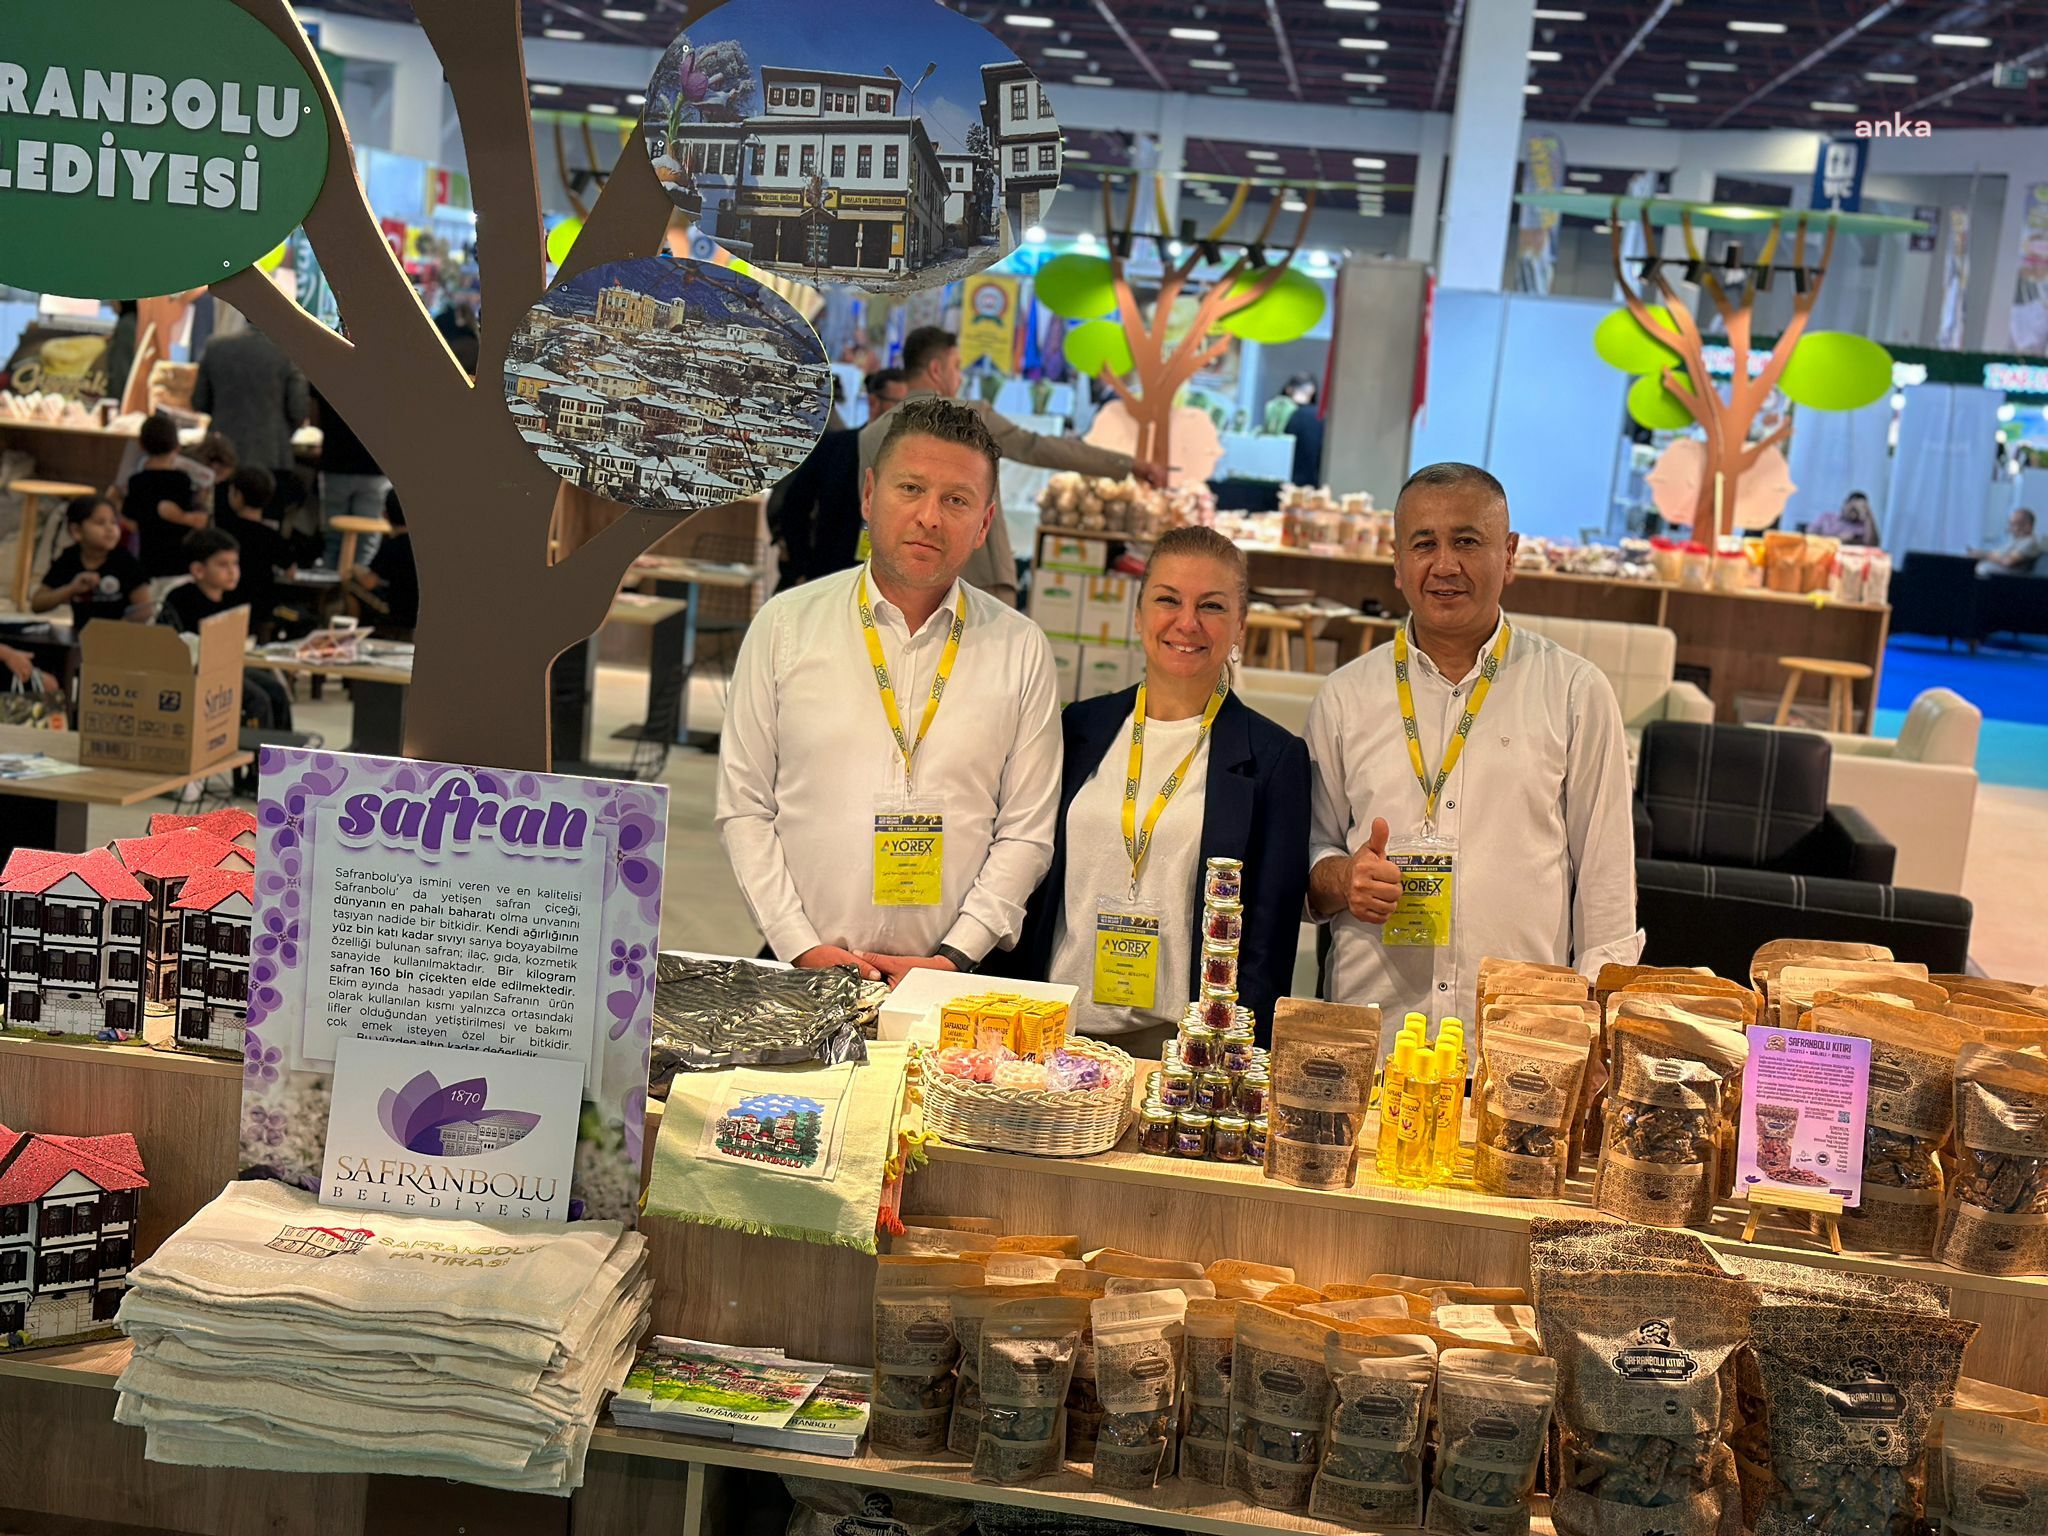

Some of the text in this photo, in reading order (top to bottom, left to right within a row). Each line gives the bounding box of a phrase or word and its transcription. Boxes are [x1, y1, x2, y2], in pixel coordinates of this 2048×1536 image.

[338, 777, 588, 850] safran
[412, 888, 427, 899] da
[441, 892, 481, 907] yetişen
[495, 897, 530, 909] safran
[544, 902, 580, 916] çiçeği,
[419, 875, 451, 888] ismini
[458, 881, 489, 892] veren
[496, 885, 510, 894] ve
[515, 887, 530, 896] en
[537, 887, 581, 901] kalitelisi
[333, 895, 579, 928] dünyanın en pahalı baharatı olma unvanını
[333, 908, 578, 943] taşıyan nadide bir bitkidir. Kendi ağırlığının
[331, 921, 578, 957] yüz bin katı kadar sıvıyı sarıya boyayabilme
[331, 935, 371, 950] özelliği
[375, 939, 421, 953] bulunan
[525, 954, 577, 968] kozmetik
[329, 962, 574, 995] safran 160 bin çiçekten elde edilmektedir.
[330, 949, 576, 984] sanayide kullanılmaktadır. Bir kilogram
[328, 989, 573, 1022] olarak kullanılan kısmı yalnızca ortasındaki
[329, 975, 574, 1009] Ekim ayında hasadı yapılan Safranın ürün
[326, 1016, 570, 1049] çok emek isteyen özel bir bitkidir.
[327, 1002, 572, 1036] lifler olduğundan yetiştirilmesi ve bakımı
[1788, 1036, 1831, 1051] SAFRANBOLU
[450, 1090, 481, 1105] 1870
[721, 1146, 804, 1169] SAFRANBOLU
[336, 1155, 558, 1203] SAFRANBOLU
[333, 1186, 551, 1221] BELEDİYESİ
[378, 1236, 545, 1256] SAFRANBOLU
[1624, 1355, 1665, 1367] SAFRANBOLU
[696, 1405, 760, 1422] SAFRANBOLU
